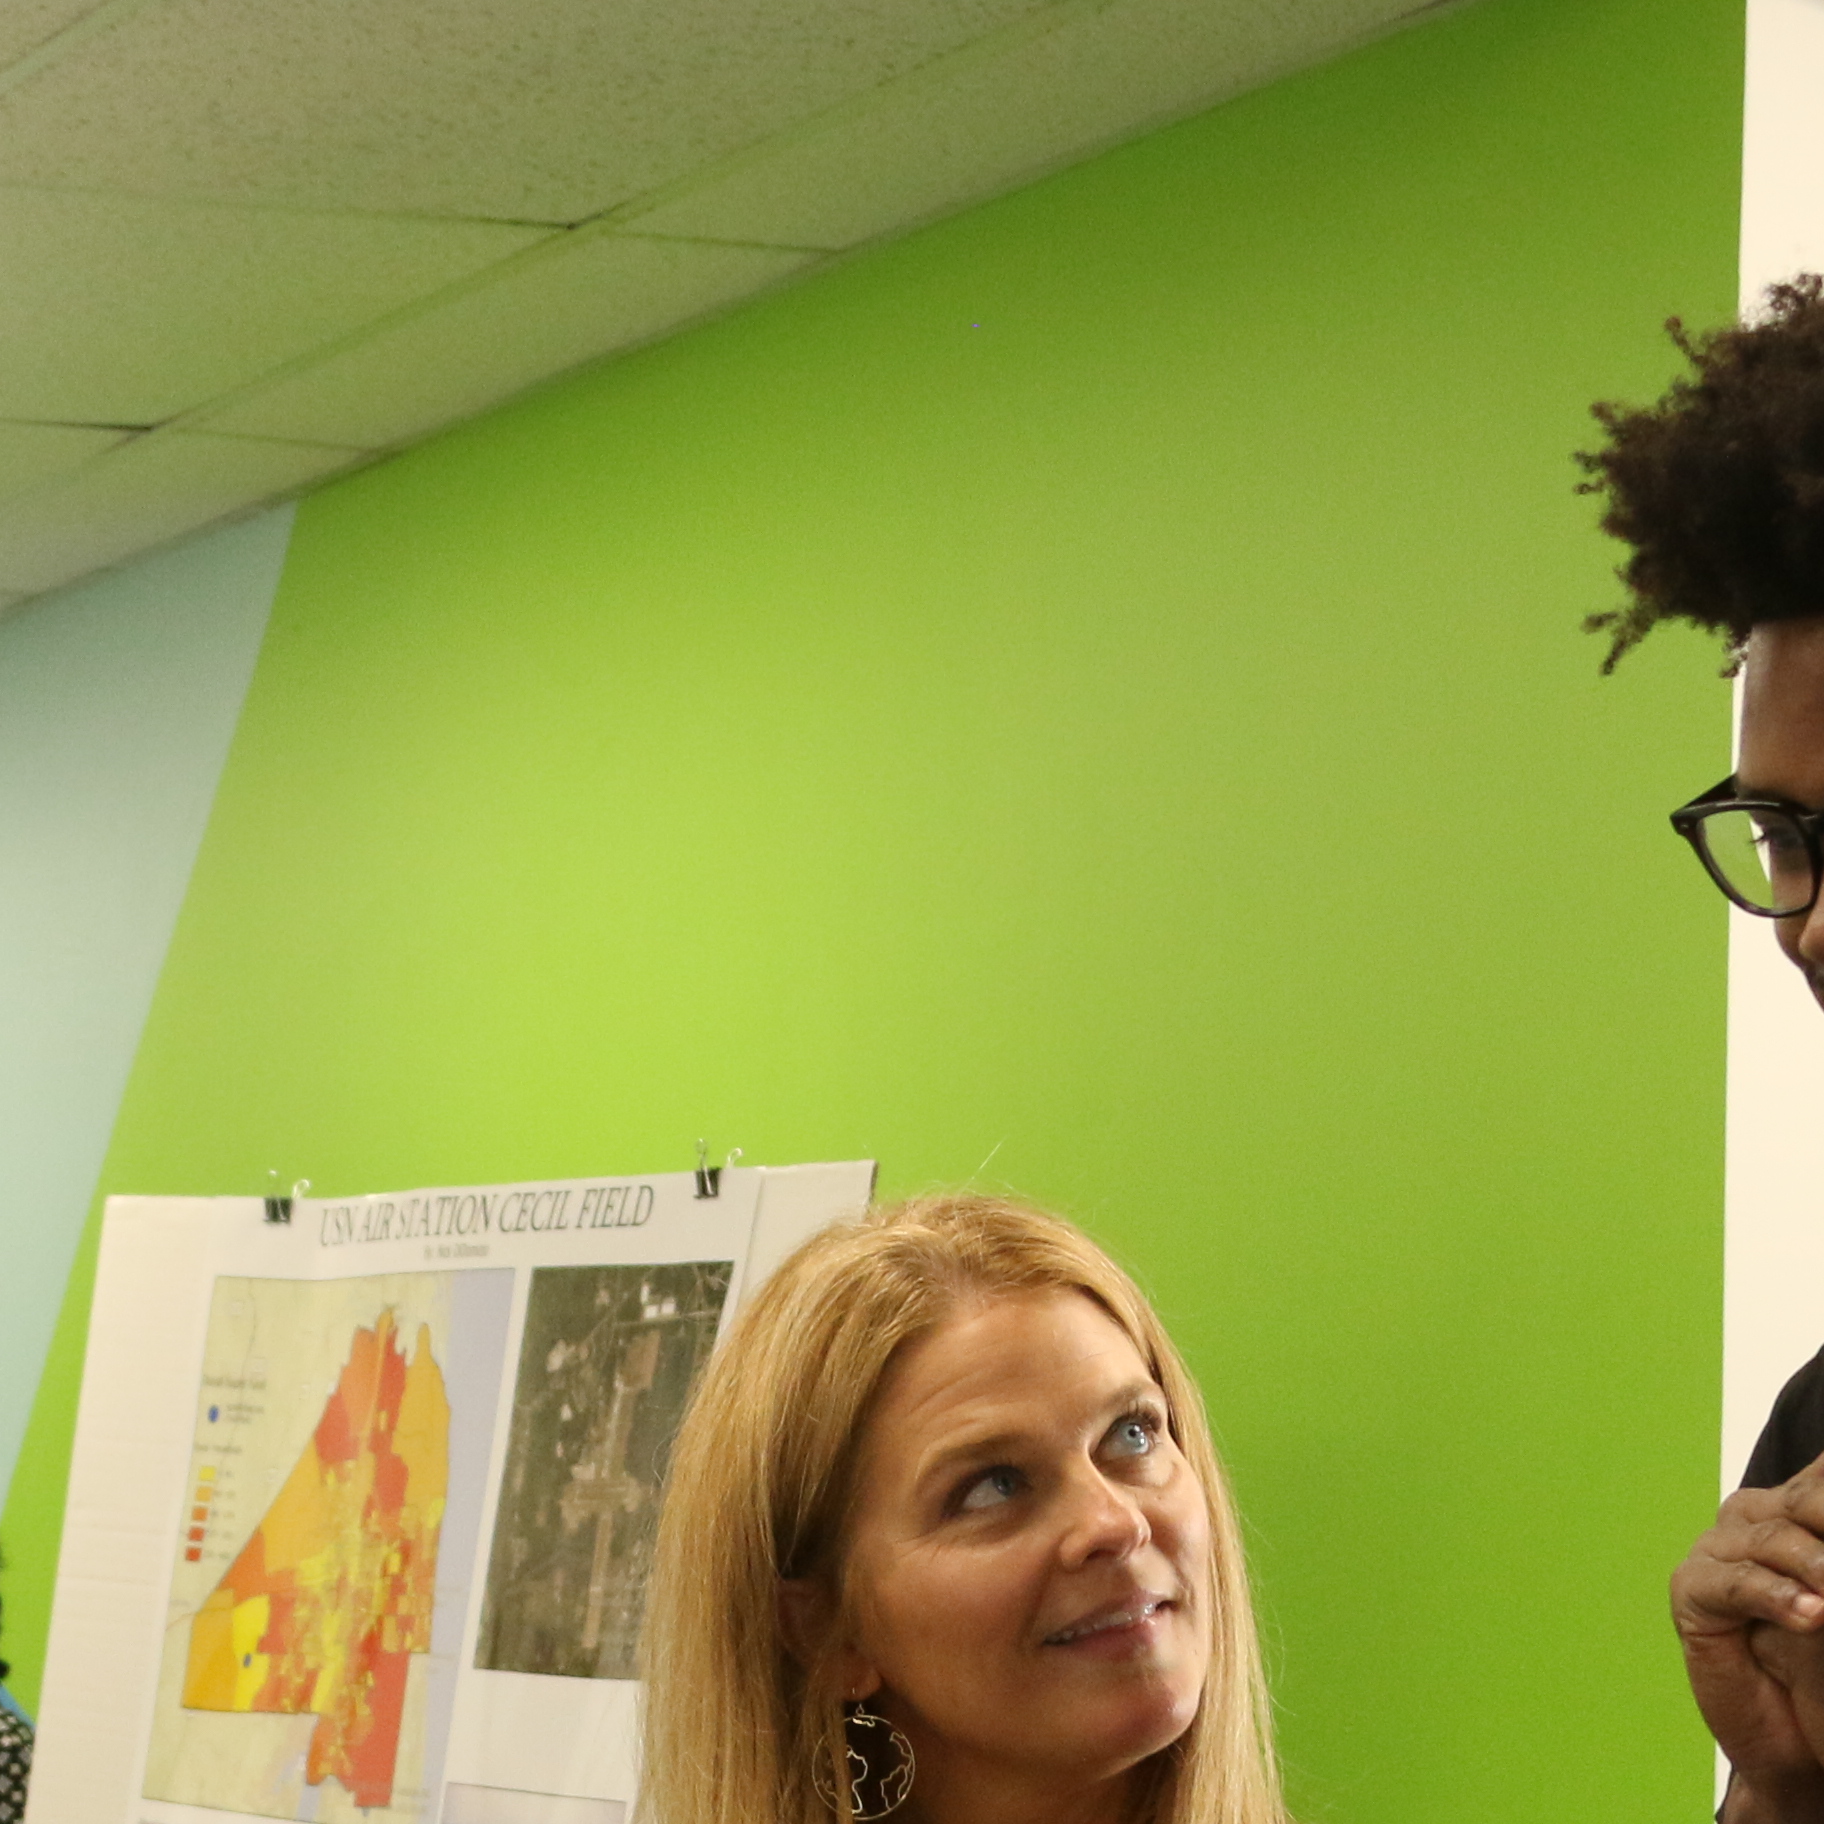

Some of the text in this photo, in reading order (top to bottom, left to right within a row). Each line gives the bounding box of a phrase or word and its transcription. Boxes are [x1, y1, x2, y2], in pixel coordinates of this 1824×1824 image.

[320, 1184, 655, 1247] USN AIR STATION CECIL FIELD
